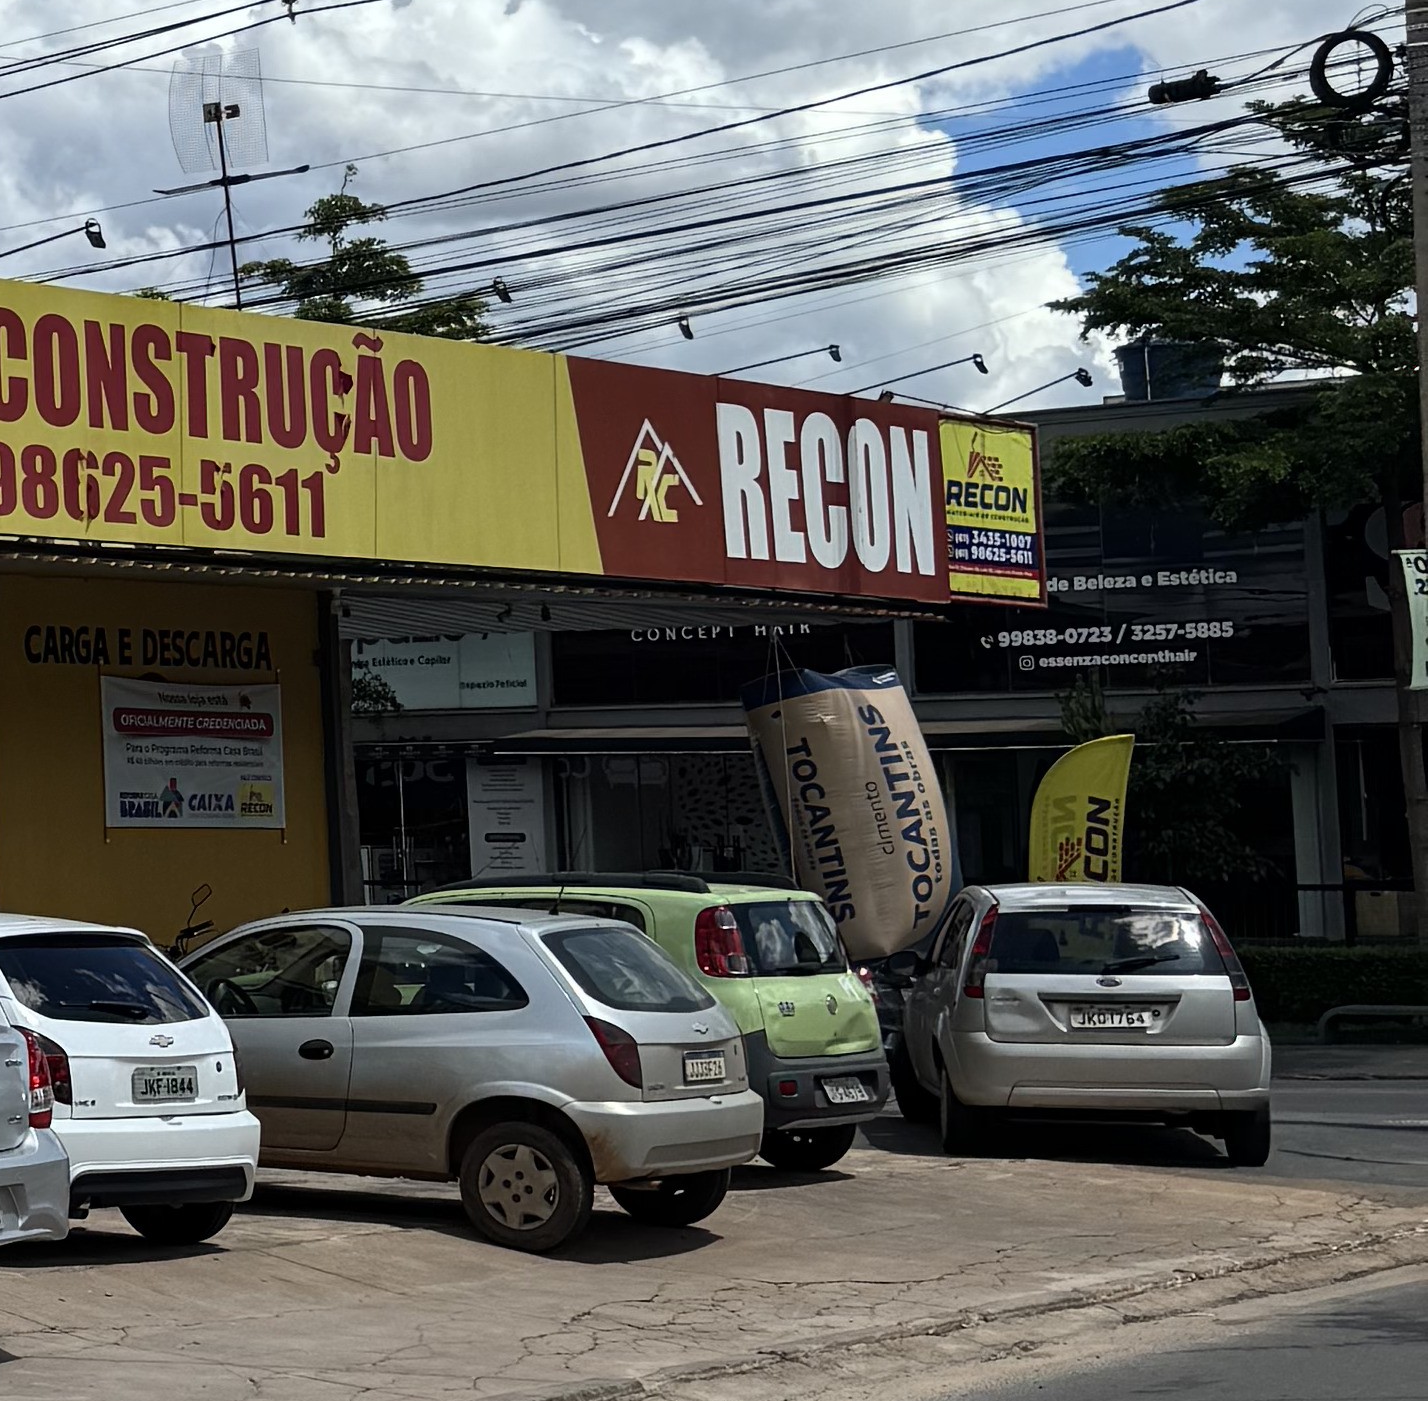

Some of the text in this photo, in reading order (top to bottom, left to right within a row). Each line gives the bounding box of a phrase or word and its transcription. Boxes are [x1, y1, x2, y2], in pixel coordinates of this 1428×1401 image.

[715, 402, 937, 577] RECON
[945, 479, 1028, 514] RECON
[972, 530, 1032, 550] 3435-1007
[971, 546, 1033, 565] 98625-5611
[1046, 568, 1238, 592] de Beleza e Estética
[998, 627, 1113, 648] 99838-0723
[1131, 621, 1234, 642] 3257-5885
[23, 624, 273, 672] CARGA E DESCARGA
[120, 713, 267, 732] OFICIALMENTE CREDENCIADA
[120, 800, 162, 818] BRASIL
[188, 794, 235, 812] CAIXA
[901, 740, 943, 884] todas as obras
[858, 703, 933, 930] TOCANTINS
[786, 737, 856, 927] TOCANTINS
[140, 1077, 194, 1096] JKF-1844
